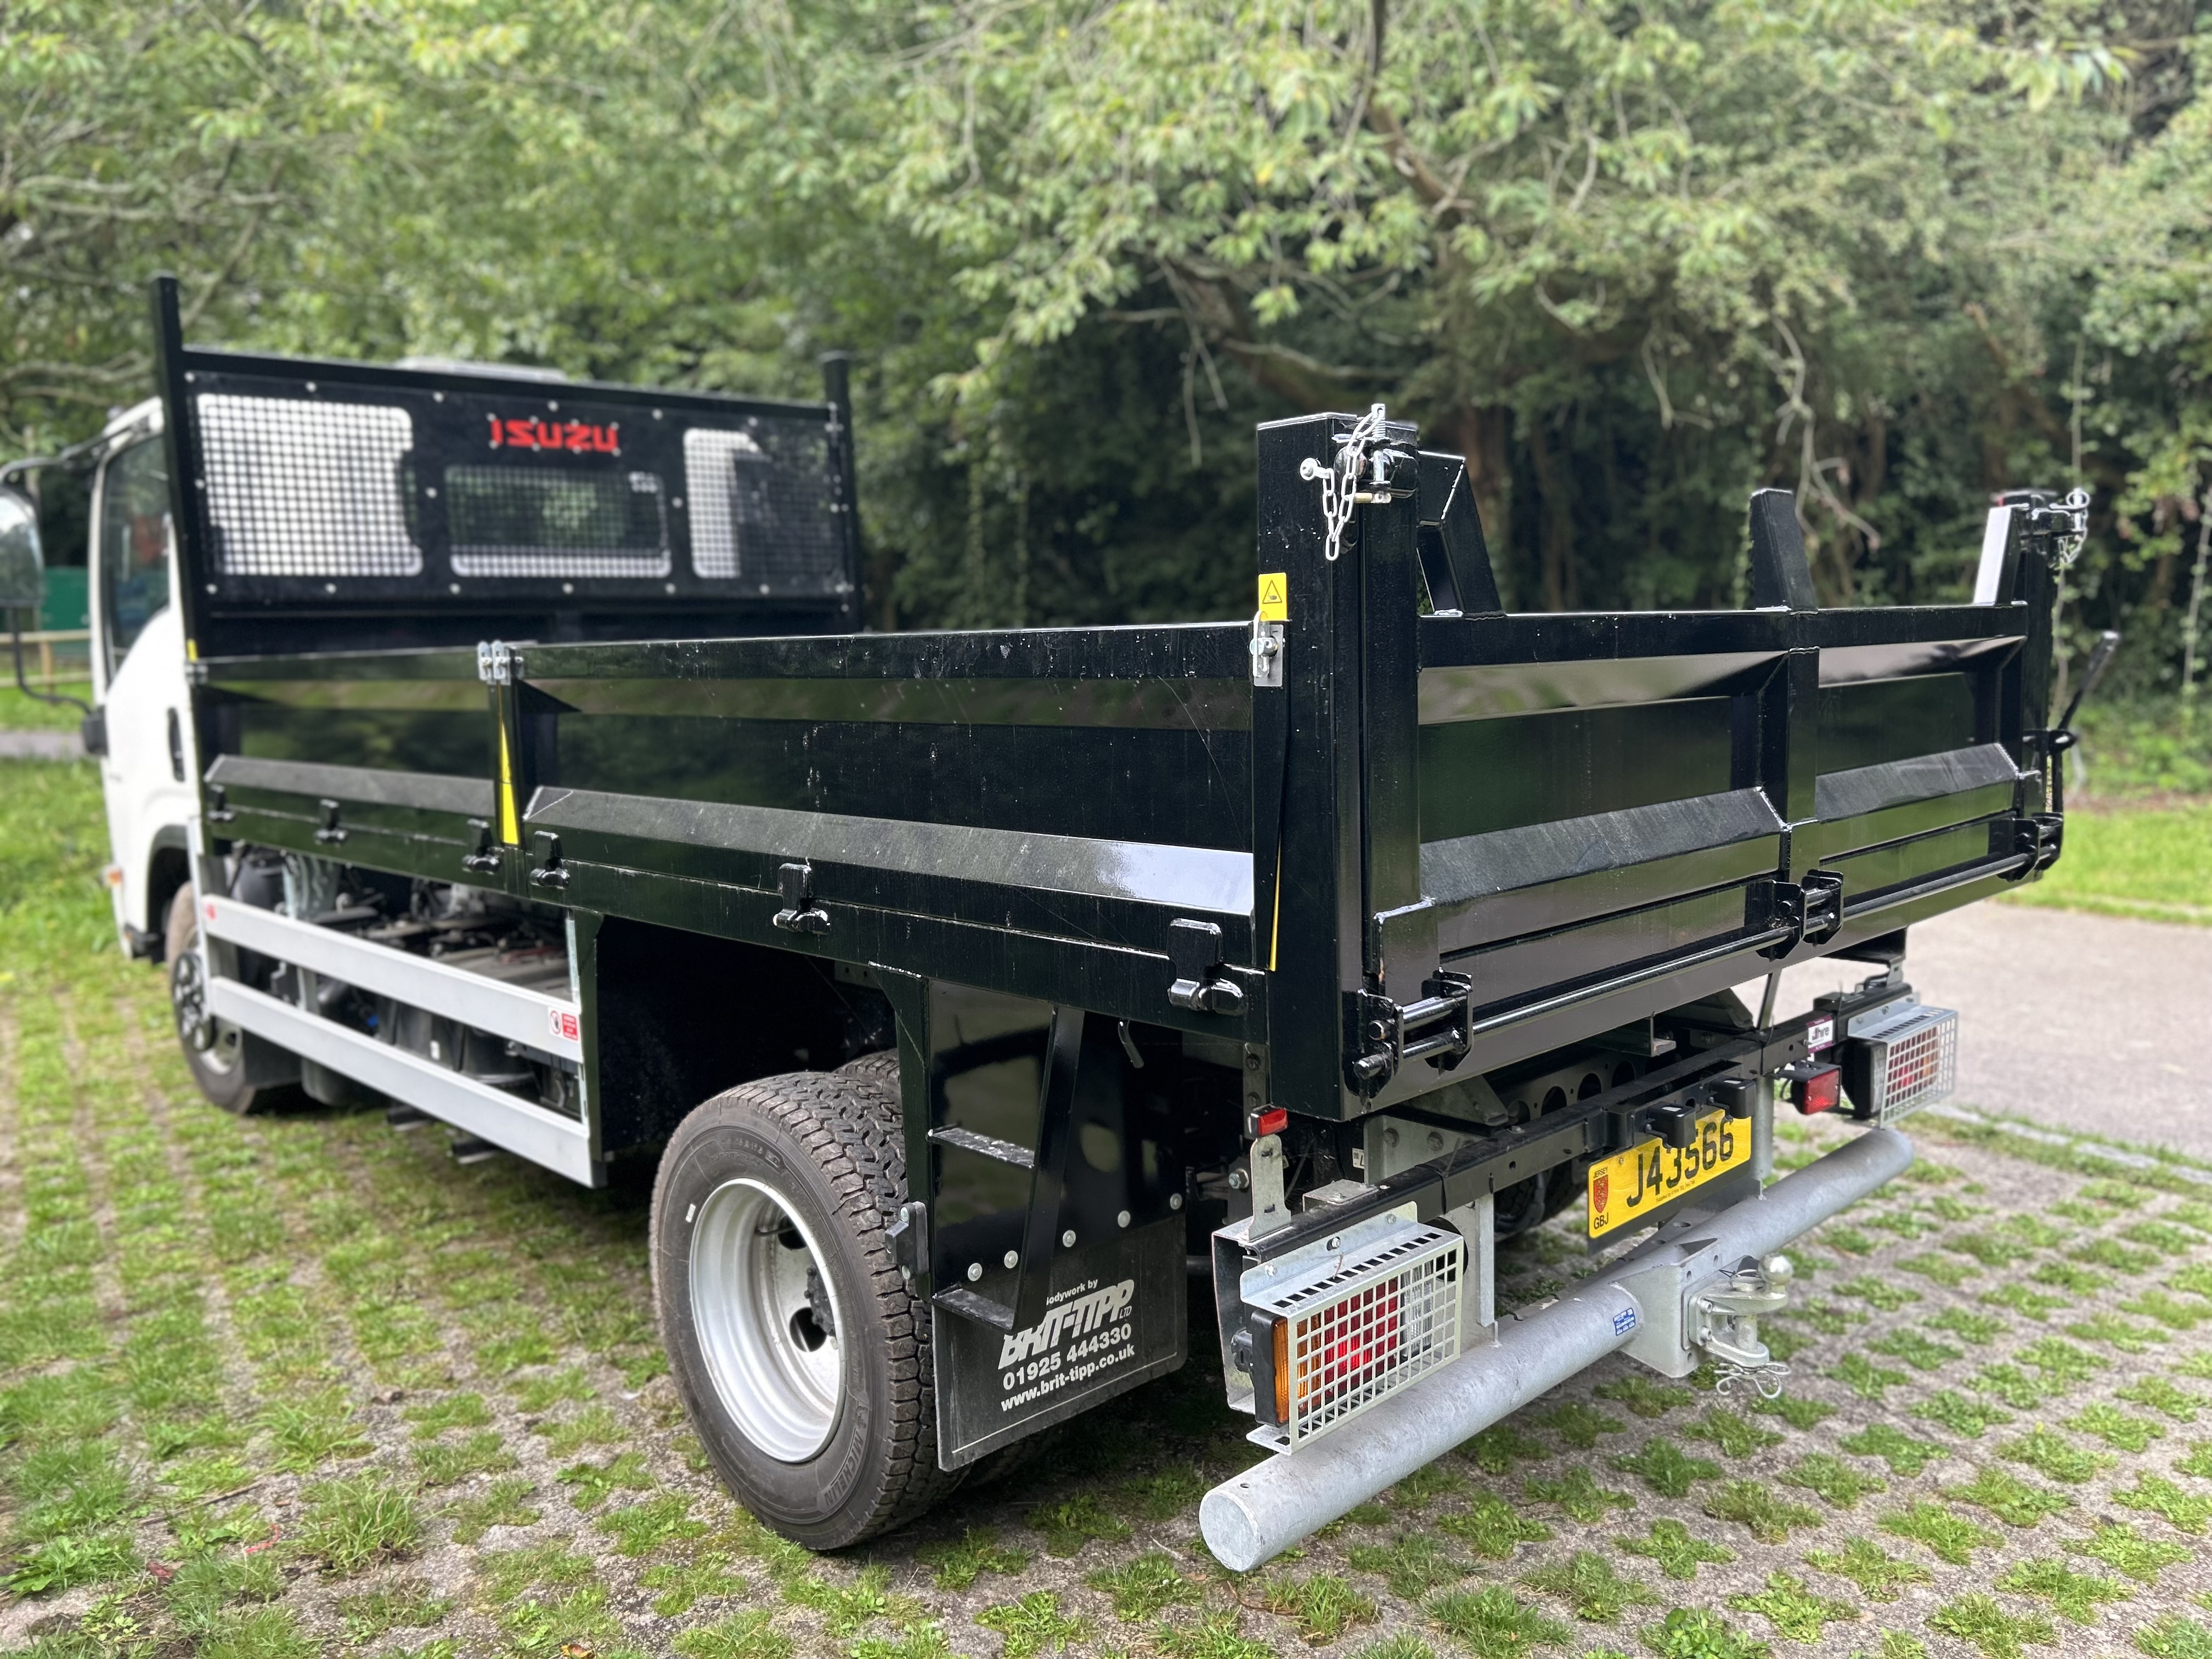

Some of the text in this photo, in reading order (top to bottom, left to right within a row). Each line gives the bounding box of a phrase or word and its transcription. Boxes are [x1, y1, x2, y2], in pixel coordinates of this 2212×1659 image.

[490, 418, 618, 452] ISUZU
[1627, 1117, 1734, 1208] J43566
[1594, 1212, 1609, 1229] GBJ
[1046, 1279, 1098, 1305] odywork by
[1119, 1306, 1132, 1319] LTD
[1001, 1344, 1135, 1412] www.brit-tipp.co.uk
[1003, 1323, 1132, 1390] 01925 444330
[824, 1430, 864, 1506] MICHELIN
